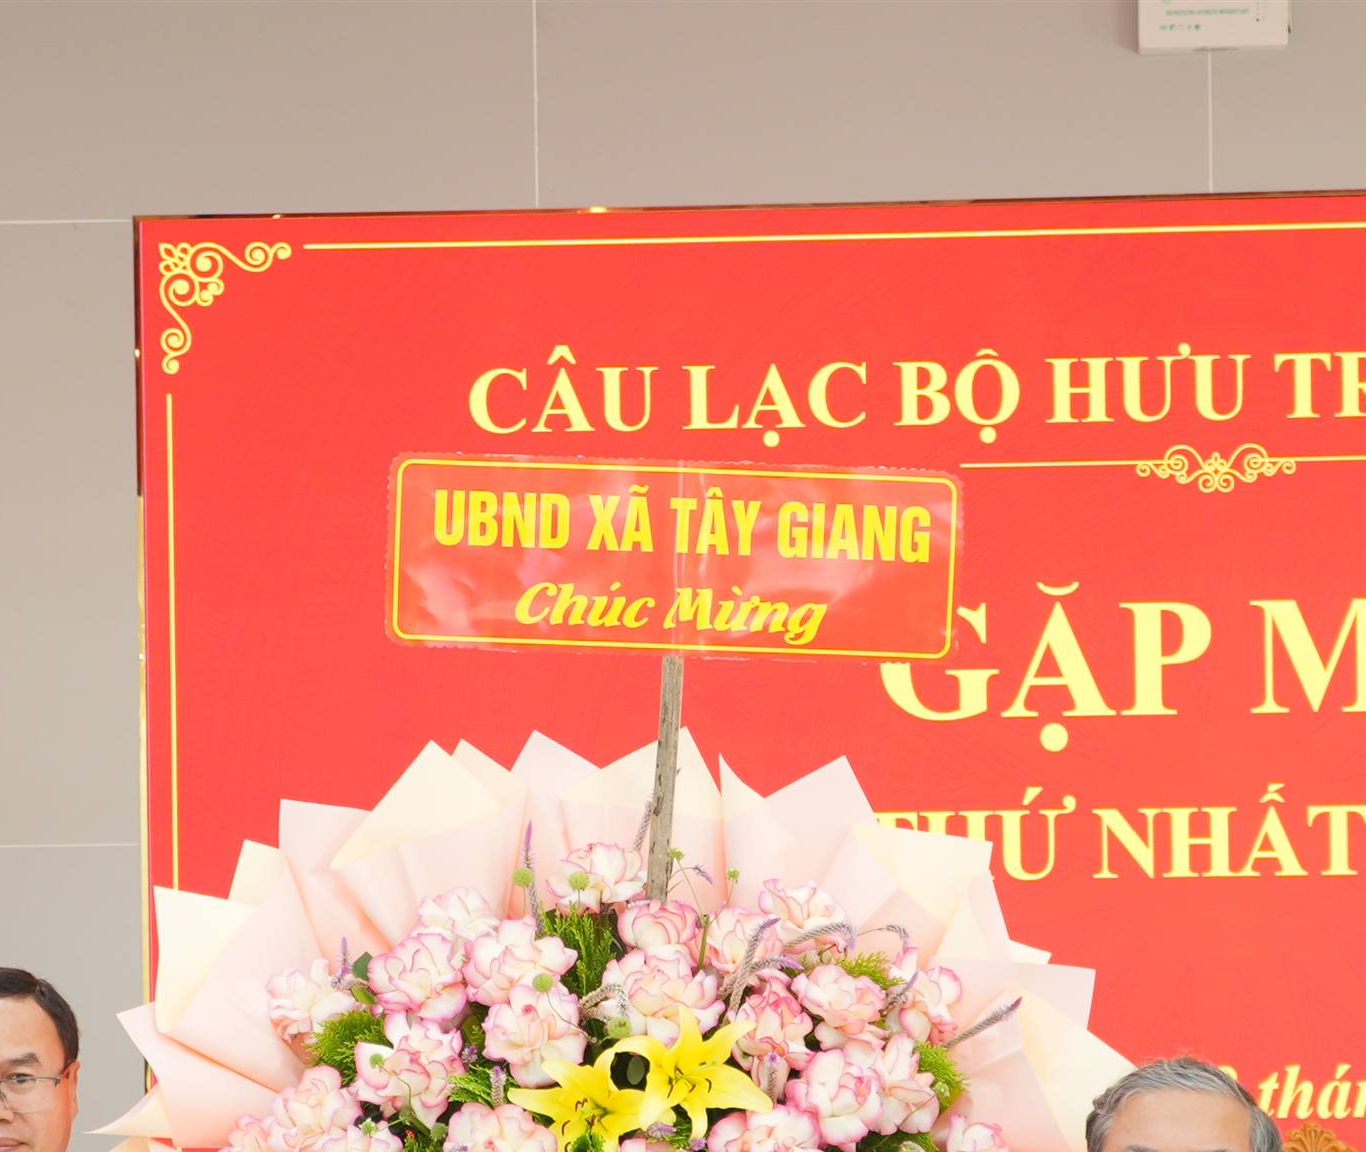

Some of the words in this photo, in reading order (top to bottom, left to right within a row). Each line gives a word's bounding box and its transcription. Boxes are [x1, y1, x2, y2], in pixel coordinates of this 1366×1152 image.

[469, 344, 659, 434] CÂU
[682, 361, 867, 448] LẠC
[893, 348, 1021, 444] BỘ
[1045, 342, 1251, 424] HƯU
[434, 489, 572, 549] UBND
[587, 485, 655, 553] XÃ
[671, 488, 763, 557] TÂY
[777, 503, 932, 563] GIANG
[515, 581, 656, 629] Chúc
[663, 585, 828, 645] Mừng
